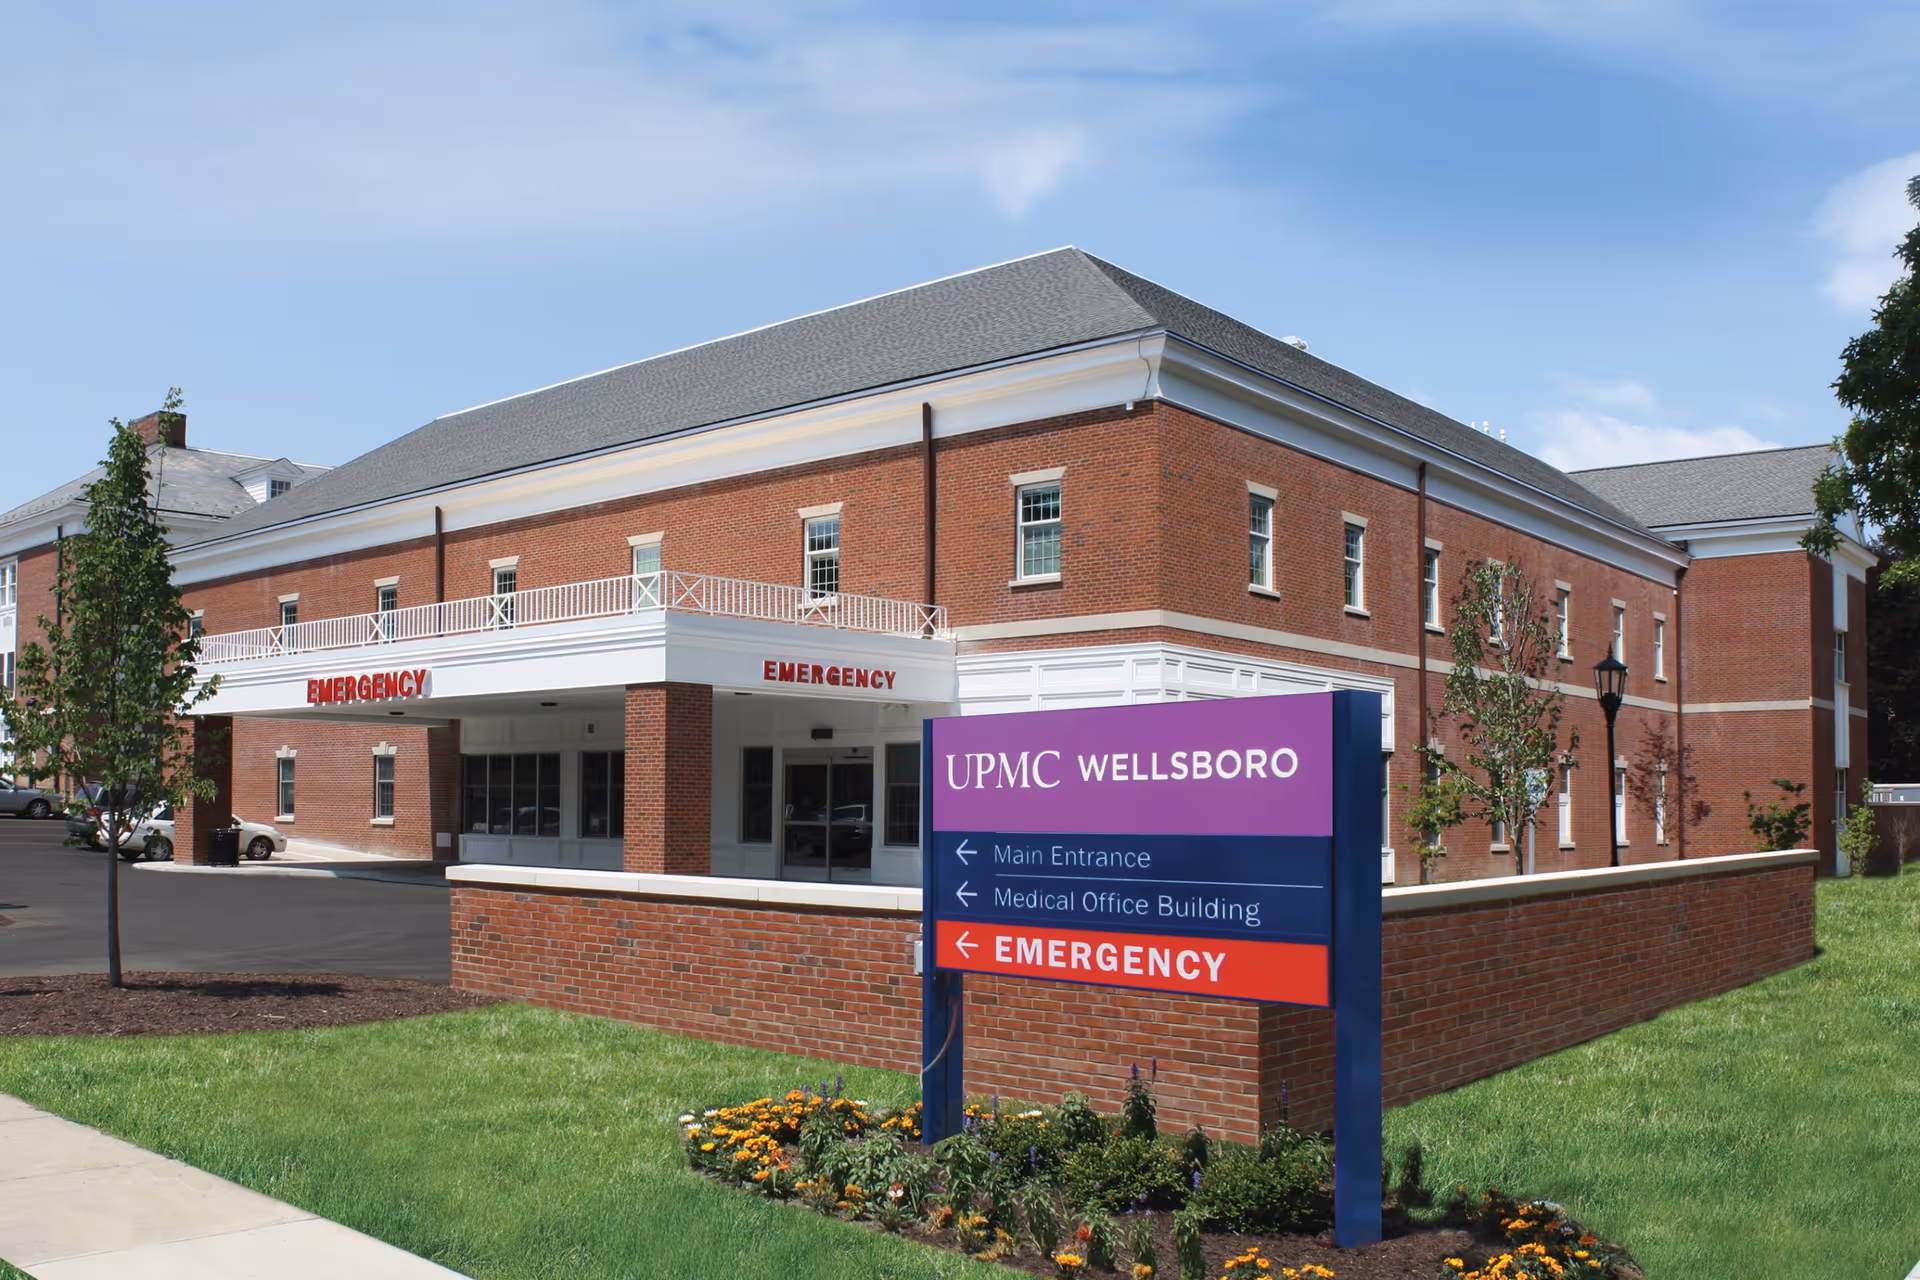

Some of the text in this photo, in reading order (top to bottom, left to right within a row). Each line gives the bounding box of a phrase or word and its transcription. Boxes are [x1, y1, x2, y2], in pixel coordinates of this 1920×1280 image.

[307, 669, 427, 704] EMERGENCY
[763, 660, 896, 690] EMERGENCY
[946, 747, 1299, 789] UPMC WELLSBORO
[994, 844, 1151, 868] Main Entrance
[994, 887, 1261, 927] Medical Office Building
[995, 935, 1226, 982] EMERGENCY
